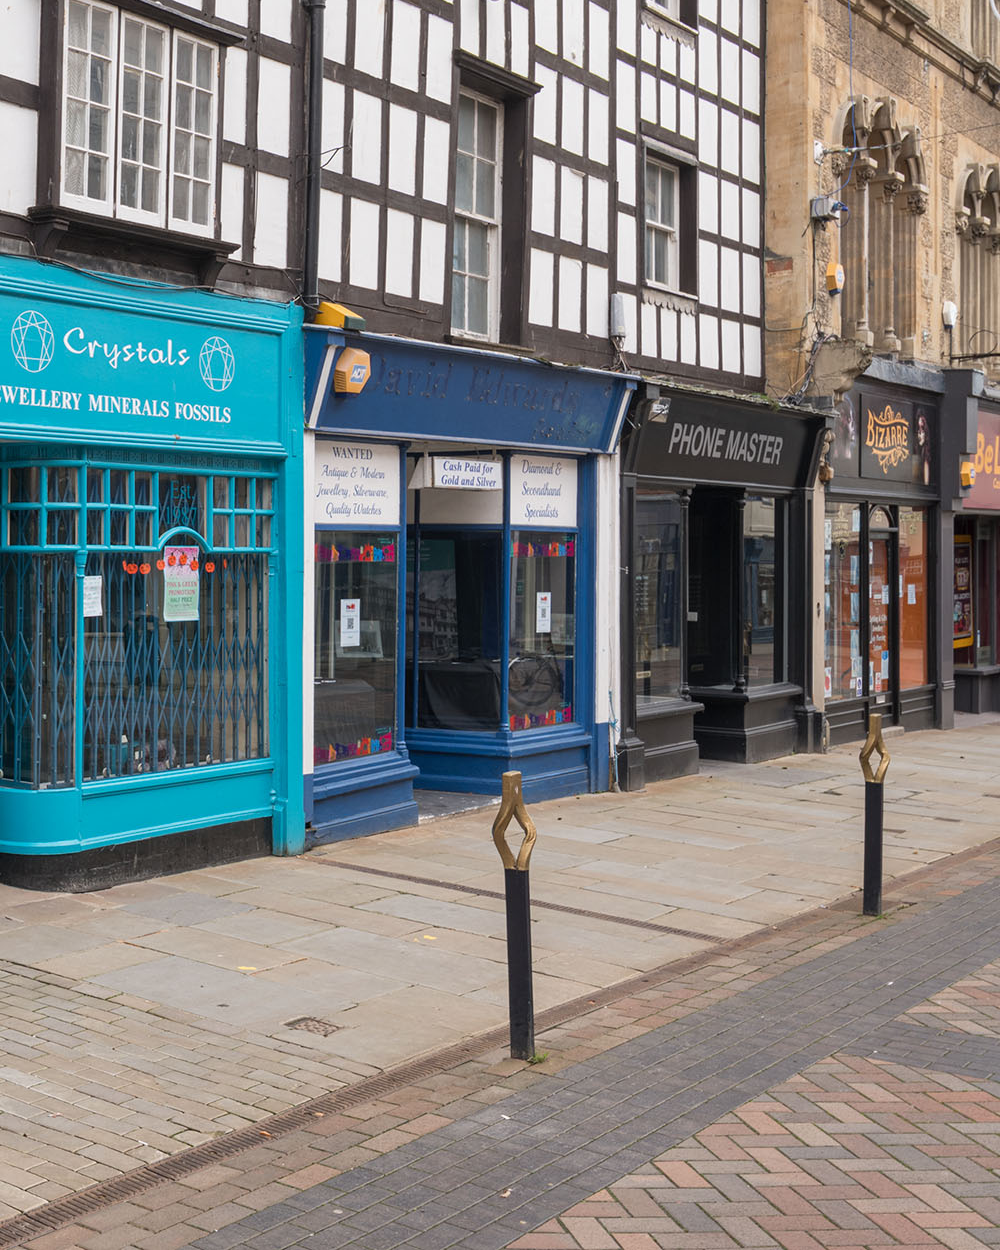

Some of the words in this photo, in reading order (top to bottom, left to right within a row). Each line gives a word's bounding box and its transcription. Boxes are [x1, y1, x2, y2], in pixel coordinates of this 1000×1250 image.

[63, 327, 190, 369] Crystals
[88, 394, 169, 418] MINERALS
[175, 402, 231, 424] FOSSILS
[865, 408, 909, 448] BIZARRE
[668, 422, 726, 458] PHONE
[725, 430, 783, 465] MASTER
[332, 446, 373, 460] WANTED
[321, 464, 349, 480] Antique
[350, 466, 358, 478] &
[360, 466, 385, 479] Modern
[443, 460, 462, 471] Cash
[464, 462, 481, 473] Paid
[482, 464, 493, 476] for
[521, 459, 554, 475] Diamond
[555, 462, 563, 476] &
[441, 474, 459, 486] Gold
[461, 477, 475, 487] and
[476, 476, 496, 487] Silver
[521, 481, 561, 497] Secondhand
[170, 480, 194, 499] Est.
[325, 502, 352, 518] Quality
[353, 503, 382, 516] Watches
[524, 502, 559, 521] Specialists
